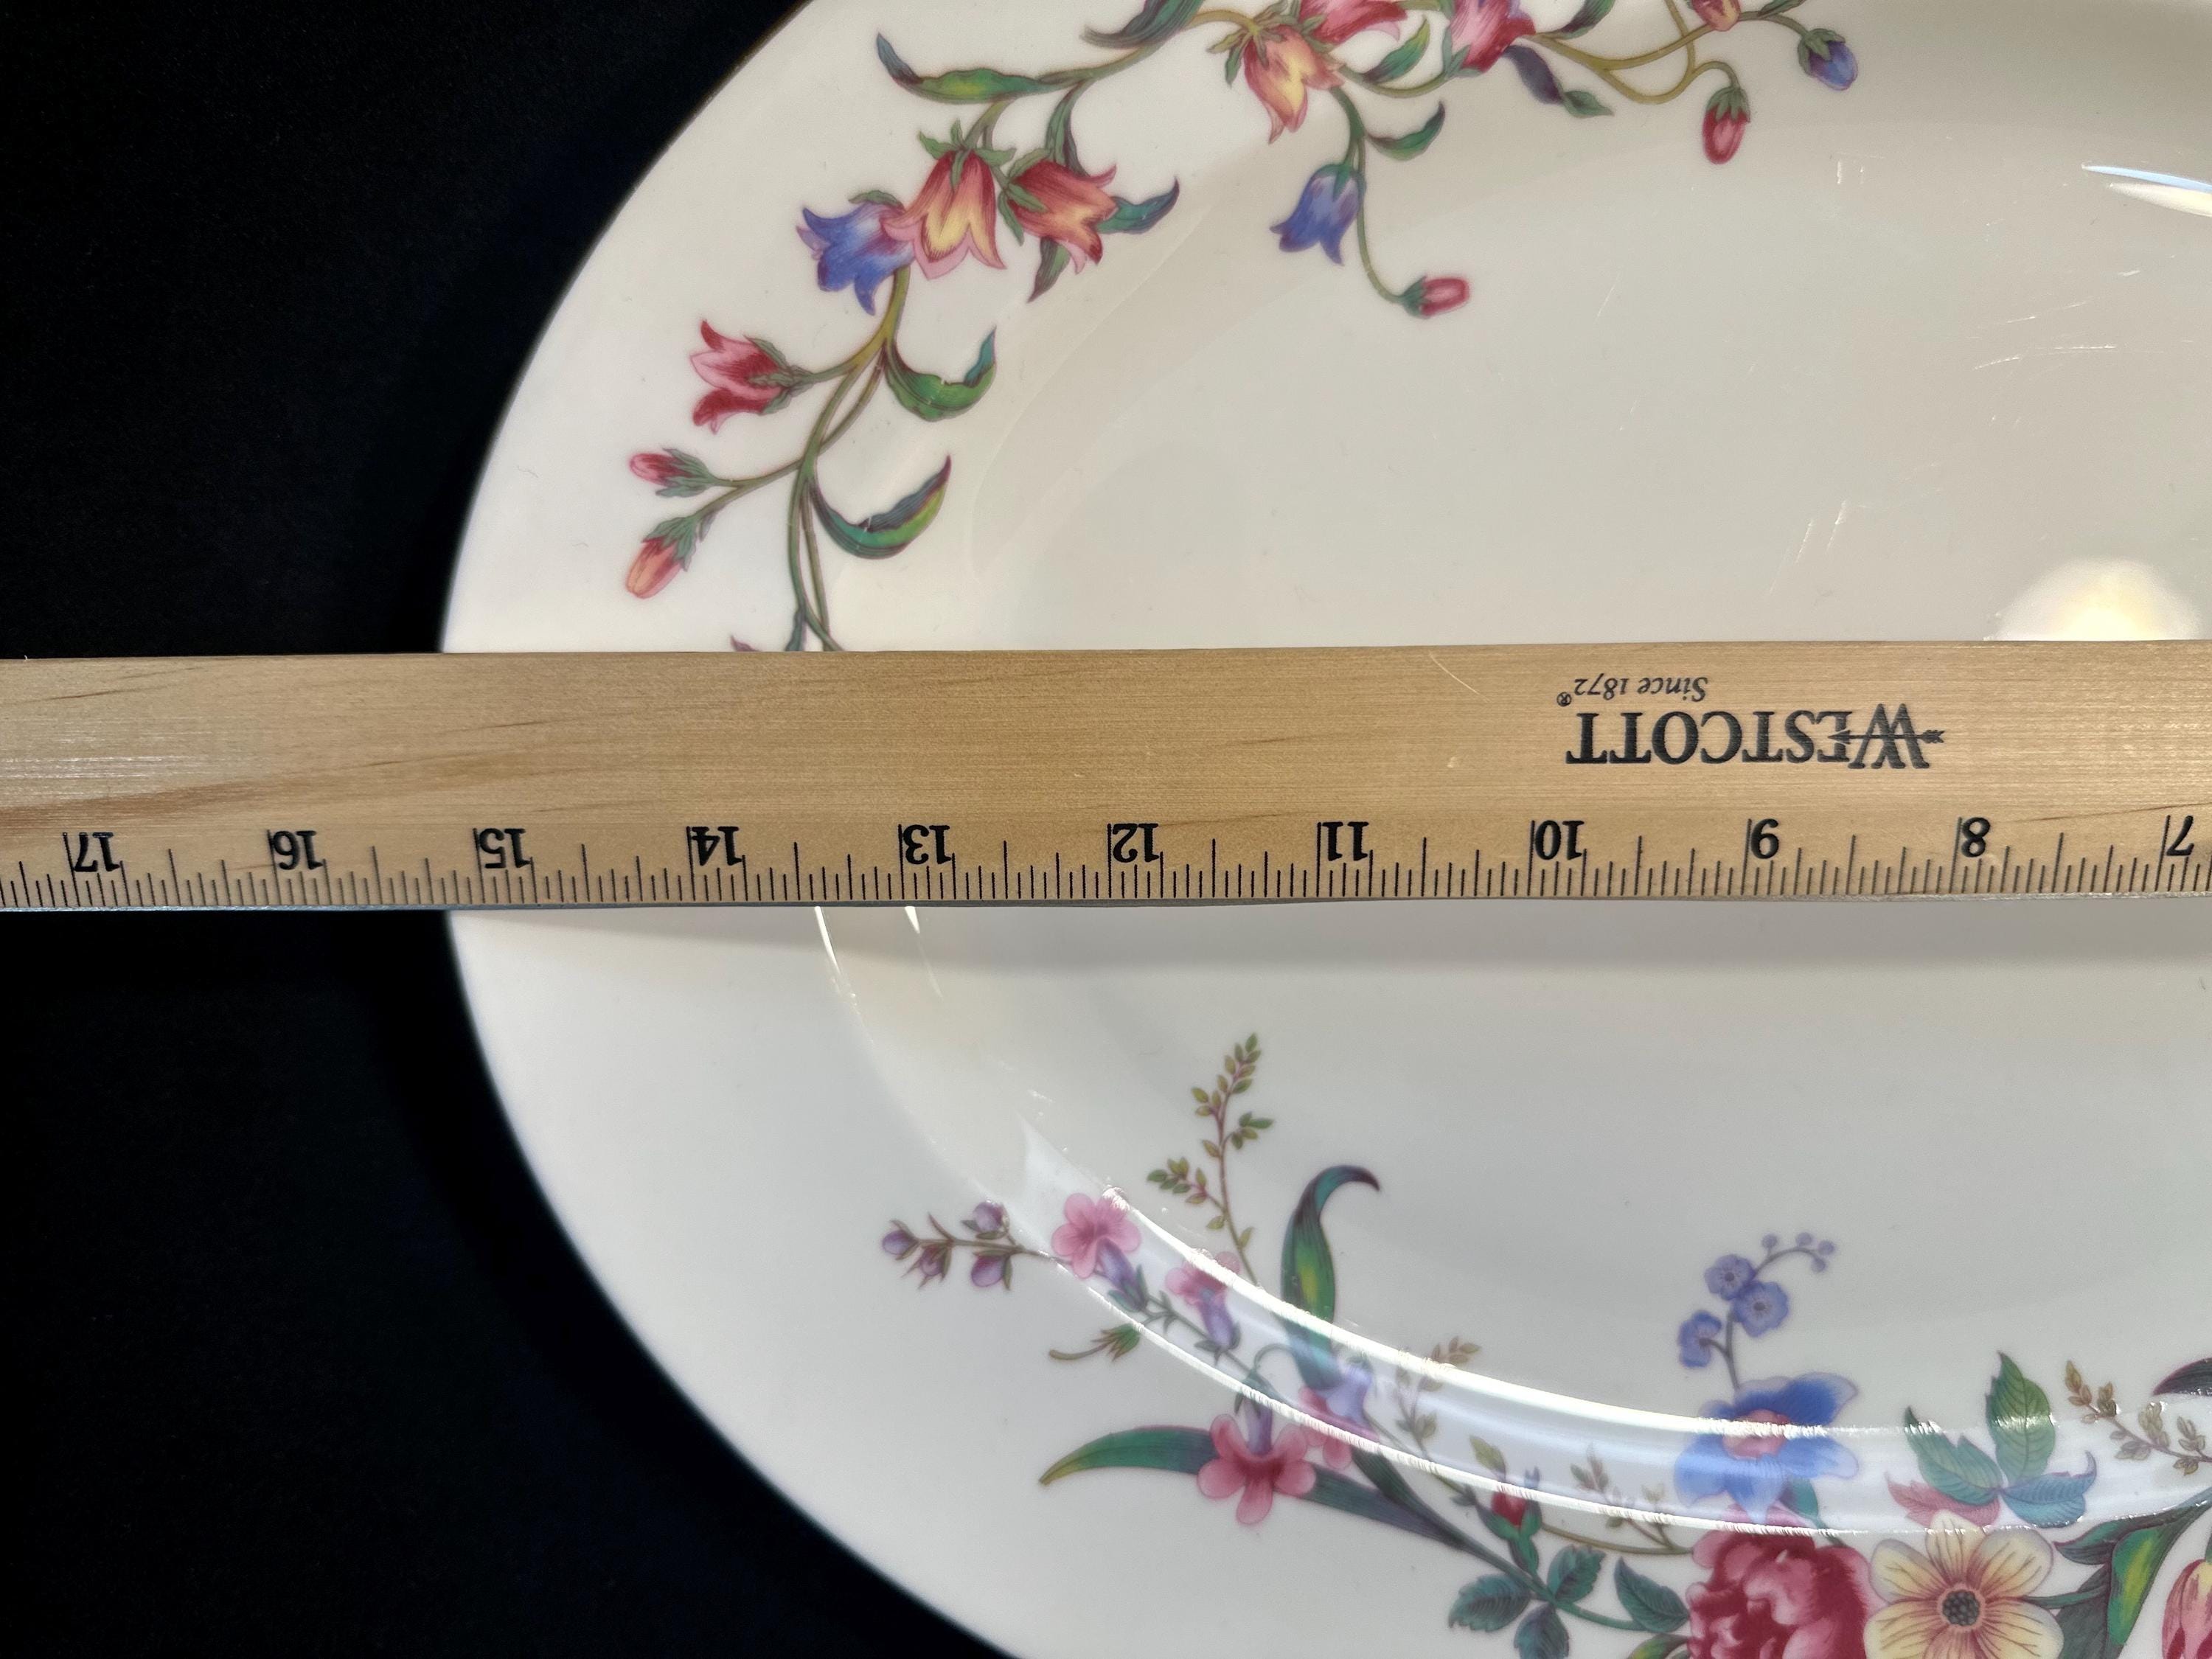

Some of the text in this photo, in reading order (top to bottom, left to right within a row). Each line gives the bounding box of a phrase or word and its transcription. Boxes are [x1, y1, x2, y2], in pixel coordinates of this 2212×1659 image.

[1636, 676, 1708, 703] Since
[1565, 703, 1930, 770] WESTCOTT
[74, 815, 2194, 872] 7 8 9 10 11 12 13 14 15 16 17
